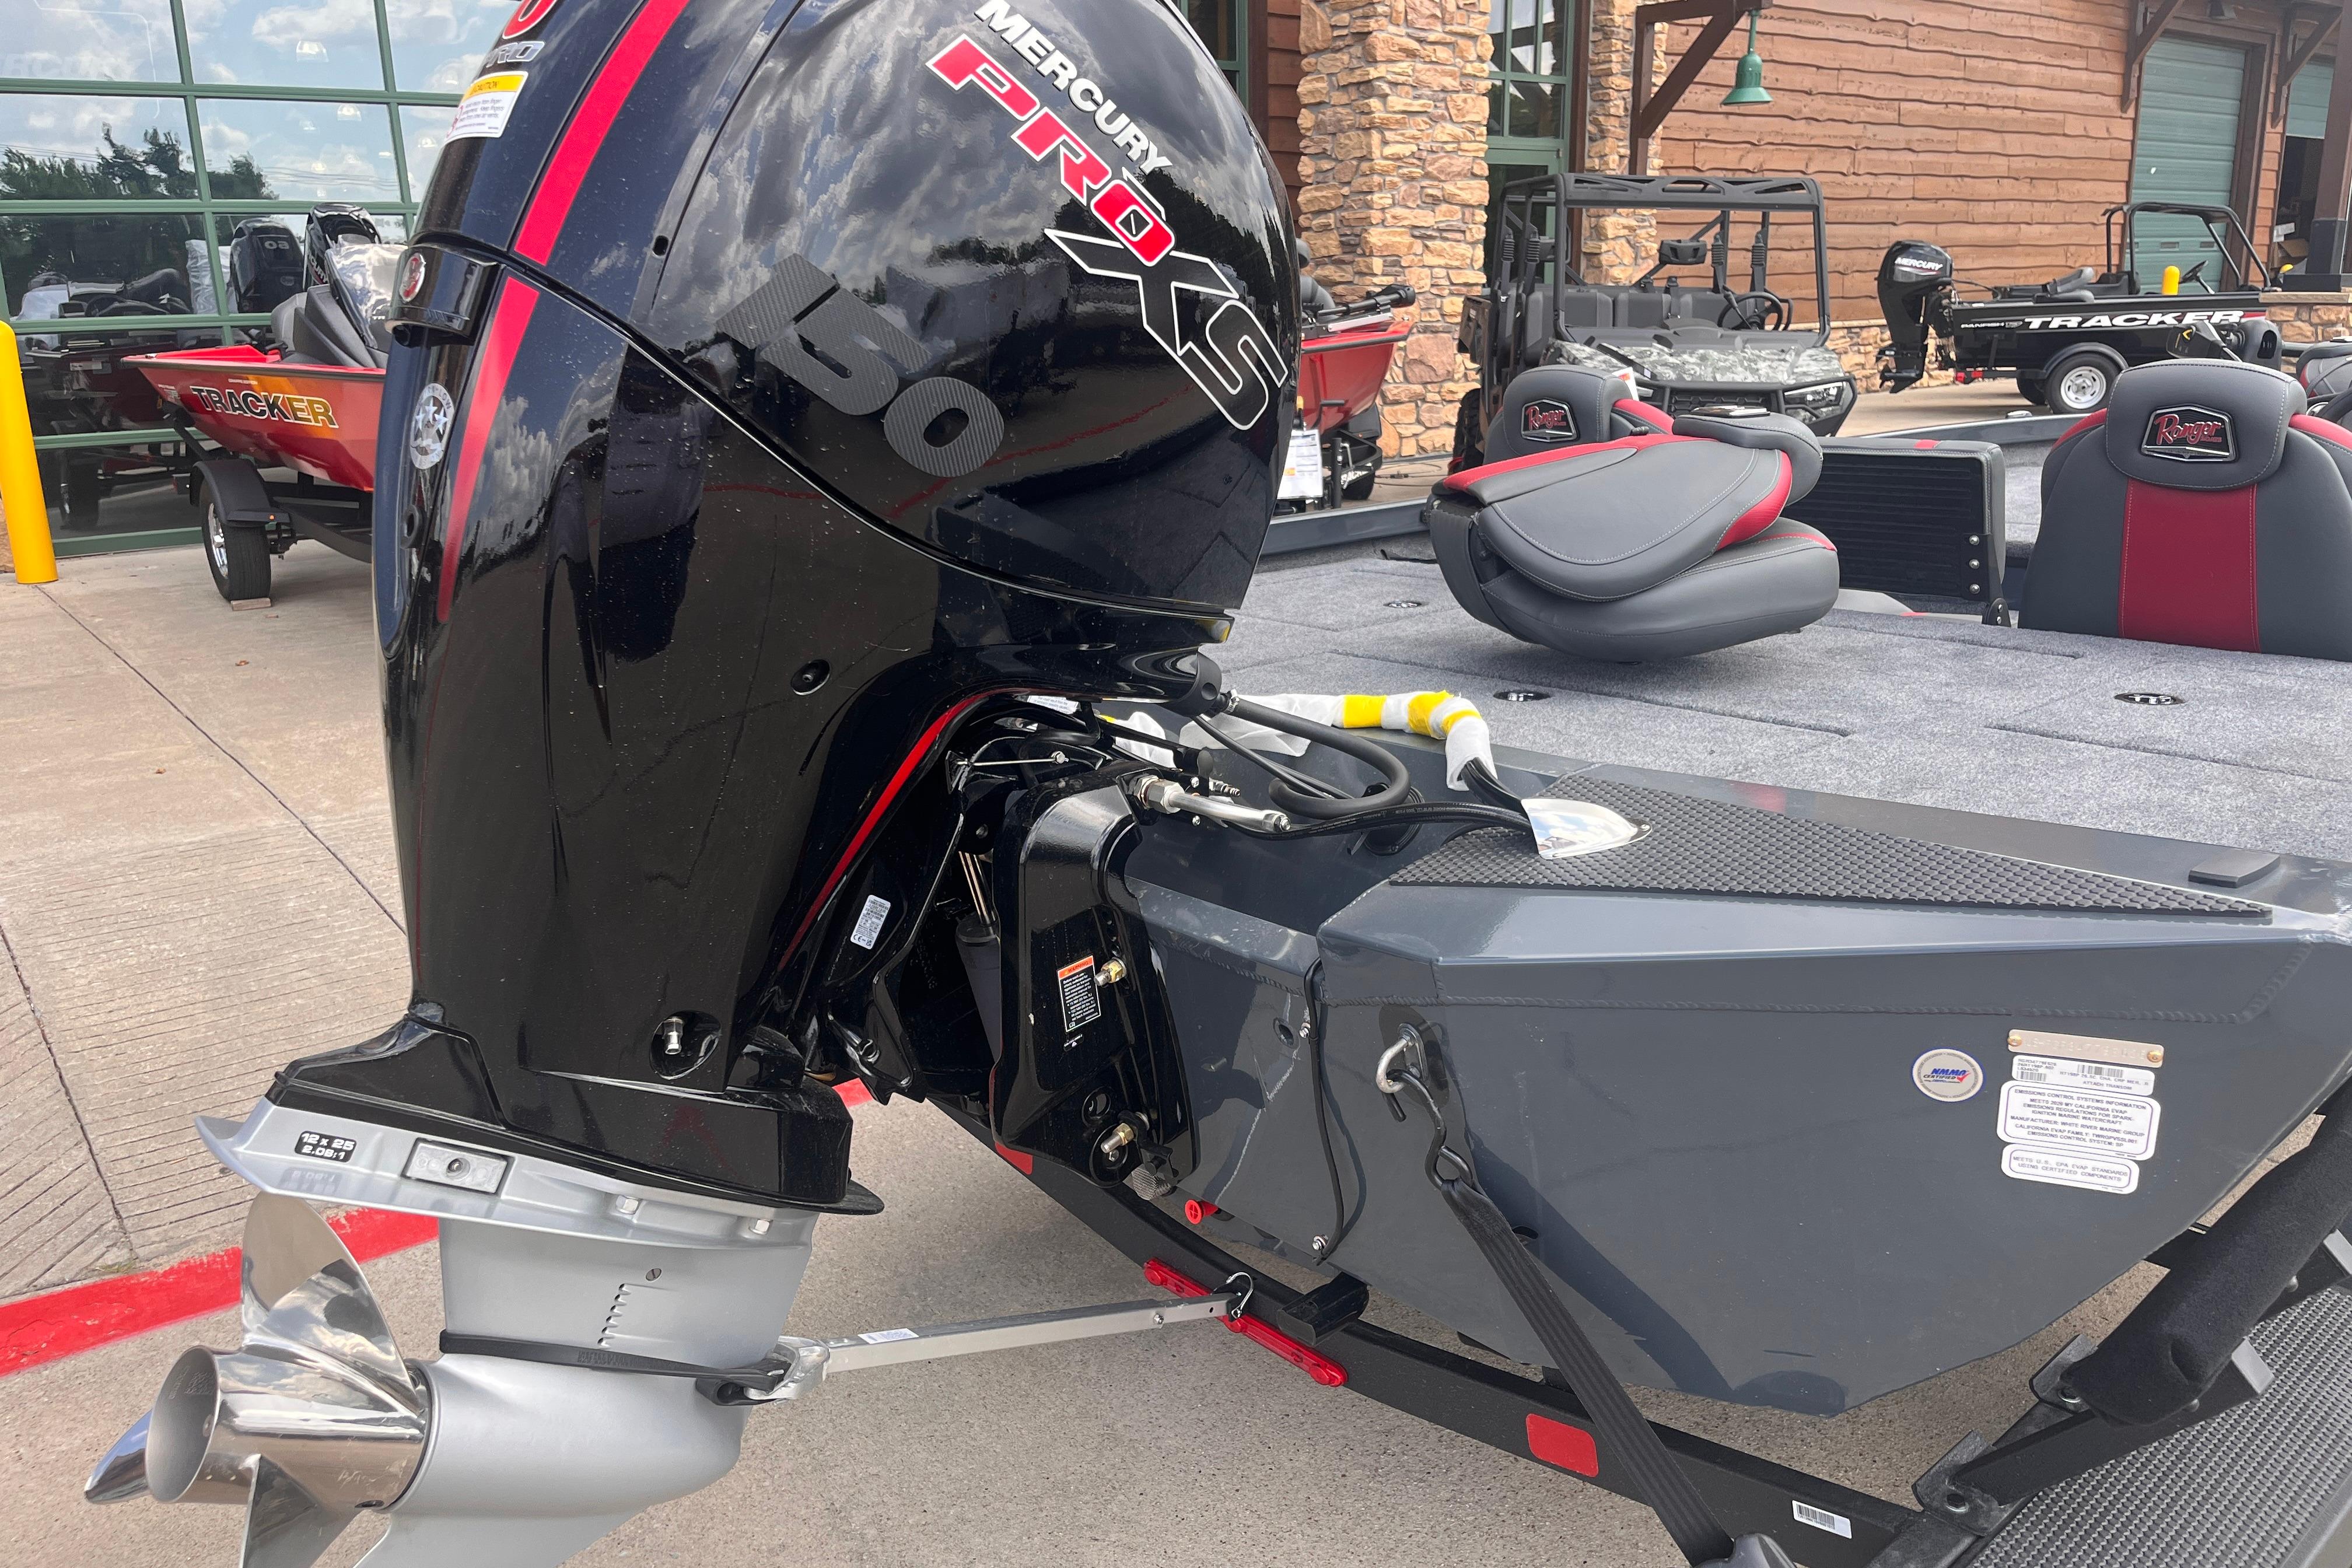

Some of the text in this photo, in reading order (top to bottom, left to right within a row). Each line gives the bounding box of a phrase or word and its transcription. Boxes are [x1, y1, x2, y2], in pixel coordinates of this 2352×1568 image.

[975, 0, 1172, 174] MERCURY
[925, 33, 1288, 430] PRO XS
[1895, 257, 1943, 271] MERCURY
[2025, 310, 2244, 329] TRACKER
[715, 253, 1005, 477] 150
[190, 386, 339, 428] TRACKER
[1525, 406, 1566, 430] Ranger
[2154, 414, 2222, 445] Ranger
[1068, 961, 1089, 973] WARNING
[2014, 1088, 2146, 1110] EMISSIONS CONTROL SYSTEMS INFORMATION
[2022, 1102, 2054, 1111] EMISSIONS
[2055, 1107, 2097, 1116] REGULATIONS
[2074, 1103, 2109, 1112] CALIFORNIA
[2015, 1123, 2049, 1132] CALIFORNIA
[2081, 1115, 2122, 1125] WATERCRAFT
[2027, 1130, 2058, 1139] EMISSIONS
[2059, 1135, 2087, 1143] CONTROL
[2099, 1126, 2122, 1134] MARINE
[302, 1133, 320, 1144] 12
[331, 1139, 355, 1150] 25
[302, 1144, 345, 1160] 2.08:1
[2041, 1166, 2077, 1175] CERTIFIED
[2080, 1171, 2122, 1181] COMPONENTS
[2091, 1166, 2128, 1177] STANDARDS
